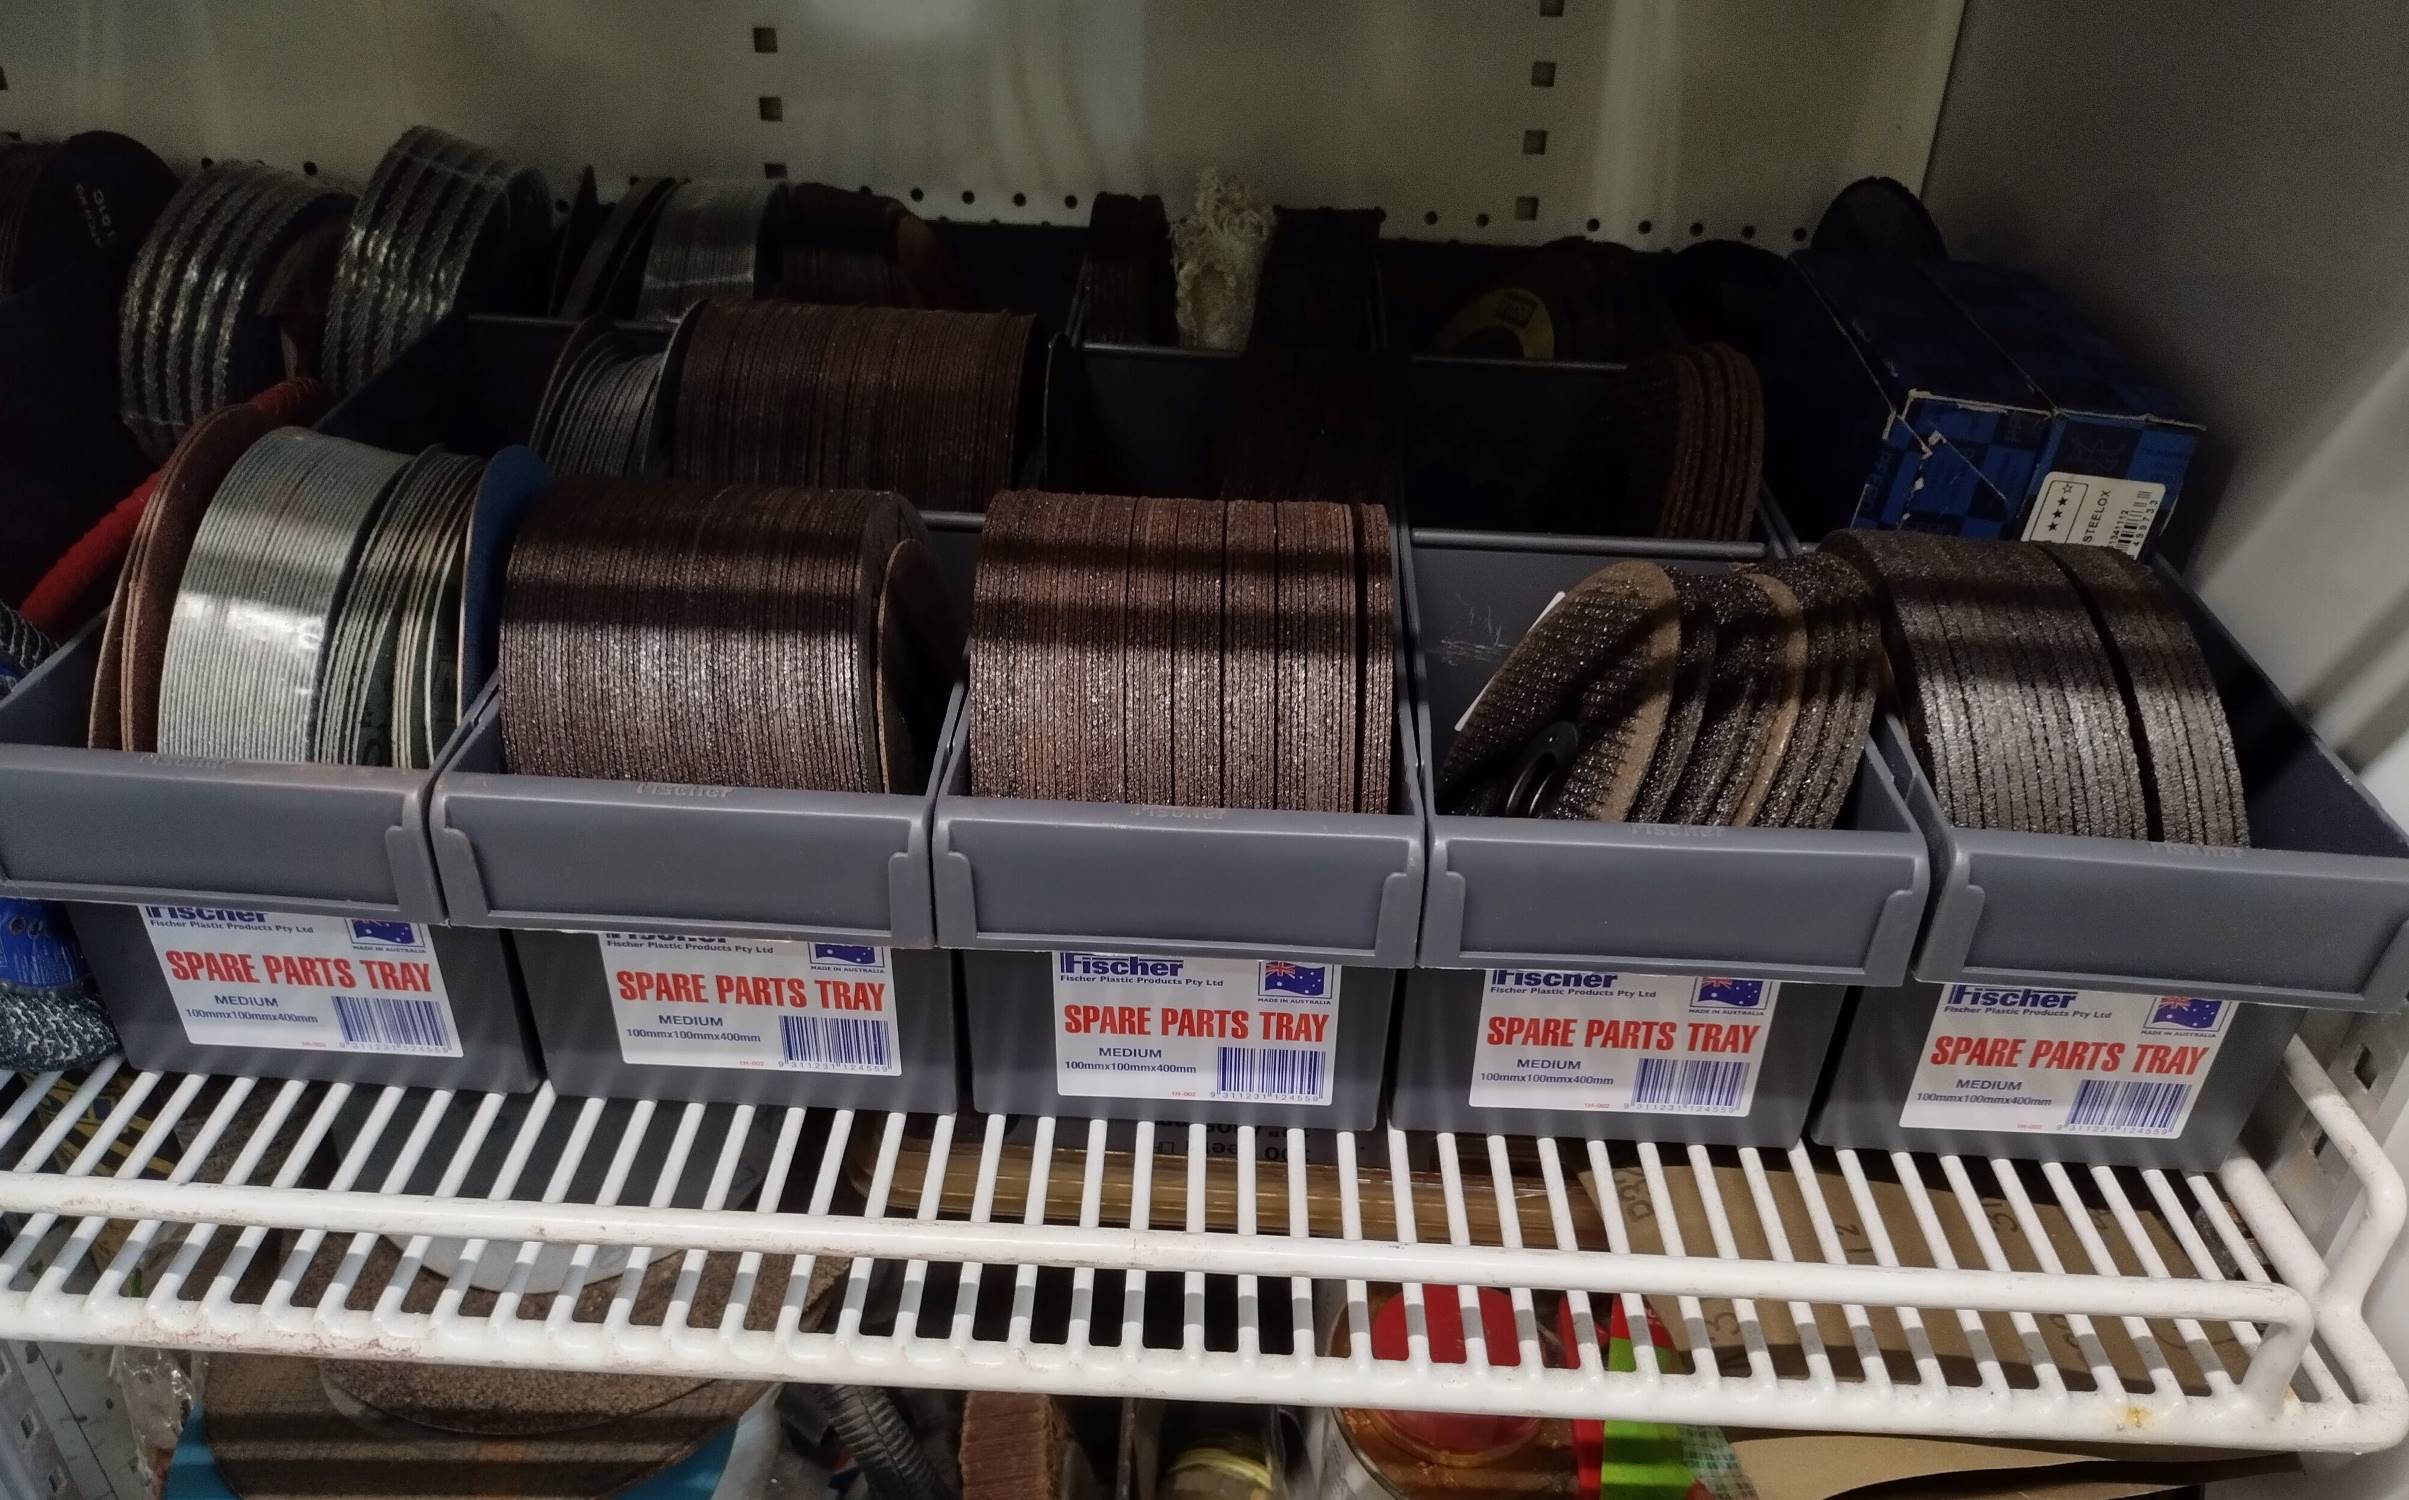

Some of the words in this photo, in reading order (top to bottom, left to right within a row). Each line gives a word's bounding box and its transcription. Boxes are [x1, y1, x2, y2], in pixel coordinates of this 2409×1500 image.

[2083, 489, 2111, 543] STEELOX
[150, 920, 187, 928] Fischer
[191, 920, 223, 930] Plastic
[227, 923, 273, 931] Products
[276, 925, 292, 934] Pty
[295, 925, 314, 934] Ltd
[607, 940, 643, 948] Fischer
[648, 941, 683, 950] Plastic
[685, 944, 731, 952] Products
[734, 945, 752, 954] Pty
[755, 946, 774, 954] Ltd
[165, 950, 260, 984] SPARE
[262, 954, 356, 989] PARTS
[359, 959, 432, 993] TRAY
[1060, 952, 1184, 977] Fischer
[1060, 975, 1096, 983] Fischer
[1100, 975, 1133, 984] Plastic
[1136, 977, 1182, 985] Products
[1185, 978, 1203, 987] Pty
[1206, 979, 1224, 987] Ltd
[616, 970, 709, 1004] SPARE
[715, 975, 807, 1009] PARTS
[814, 979, 885, 1012] TRAY
[1490, 986, 1527, 994] Fischer
[1530, 987, 1565, 995] Plastic
[1567, 988, 1614, 997] Products
[1617, 990, 1635, 999] Pty
[1638, 990, 1657, 998] Ltd
[1947, 984, 2078, 1008] Fischer
[214, 995, 279, 1007] MEDIUM
[185, 1008, 319, 1023] 100mmx100mmx400mm
[1944, 1005, 1981, 1013] Fischer
[1985, 1006, 2019, 1015] Plastic
[2022, 1008, 2069, 1017] Products
[2072, 1010, 2090, 1019] Pty
[2093, 1011, 2112, 1019] Ltd
[658, 1014, 723, 1026] MEDIUM
[1064, 1004, 1151, 1036] SPARE
[1161, 1007, 1249, 1040] PARTS
[1259, 1011, 1329, 1042] TRAY
[626, 1028, 761, 1042] 100mmx100mmx400mm
[1487, 1016, 1578, 1048] SPARE
[1584, 1019, 1677, 1051] PARTS
[1687, 1023, 1761, 1054] TRAY
[1099, 1047, 1162, 1058] MEDIUM
[1930, 1035, 2027, 1068] SPARE
[2029, 1039, 2126, 1072] PARTS
[2132, 1044, 2210, 1075] TRAY
[1065, 1061, 1197, 1073] 100mmx100mmx400mm
[1516, 1059, 1582, 1070] MEDIUM
[1481, 1072, 1614, 1085] 100mmx100mmx400mm
[1956, 1079, 2022, 1090] MEDIUM
[1917, 1092, 2052, 1106] 100mmx100mmx400mm
